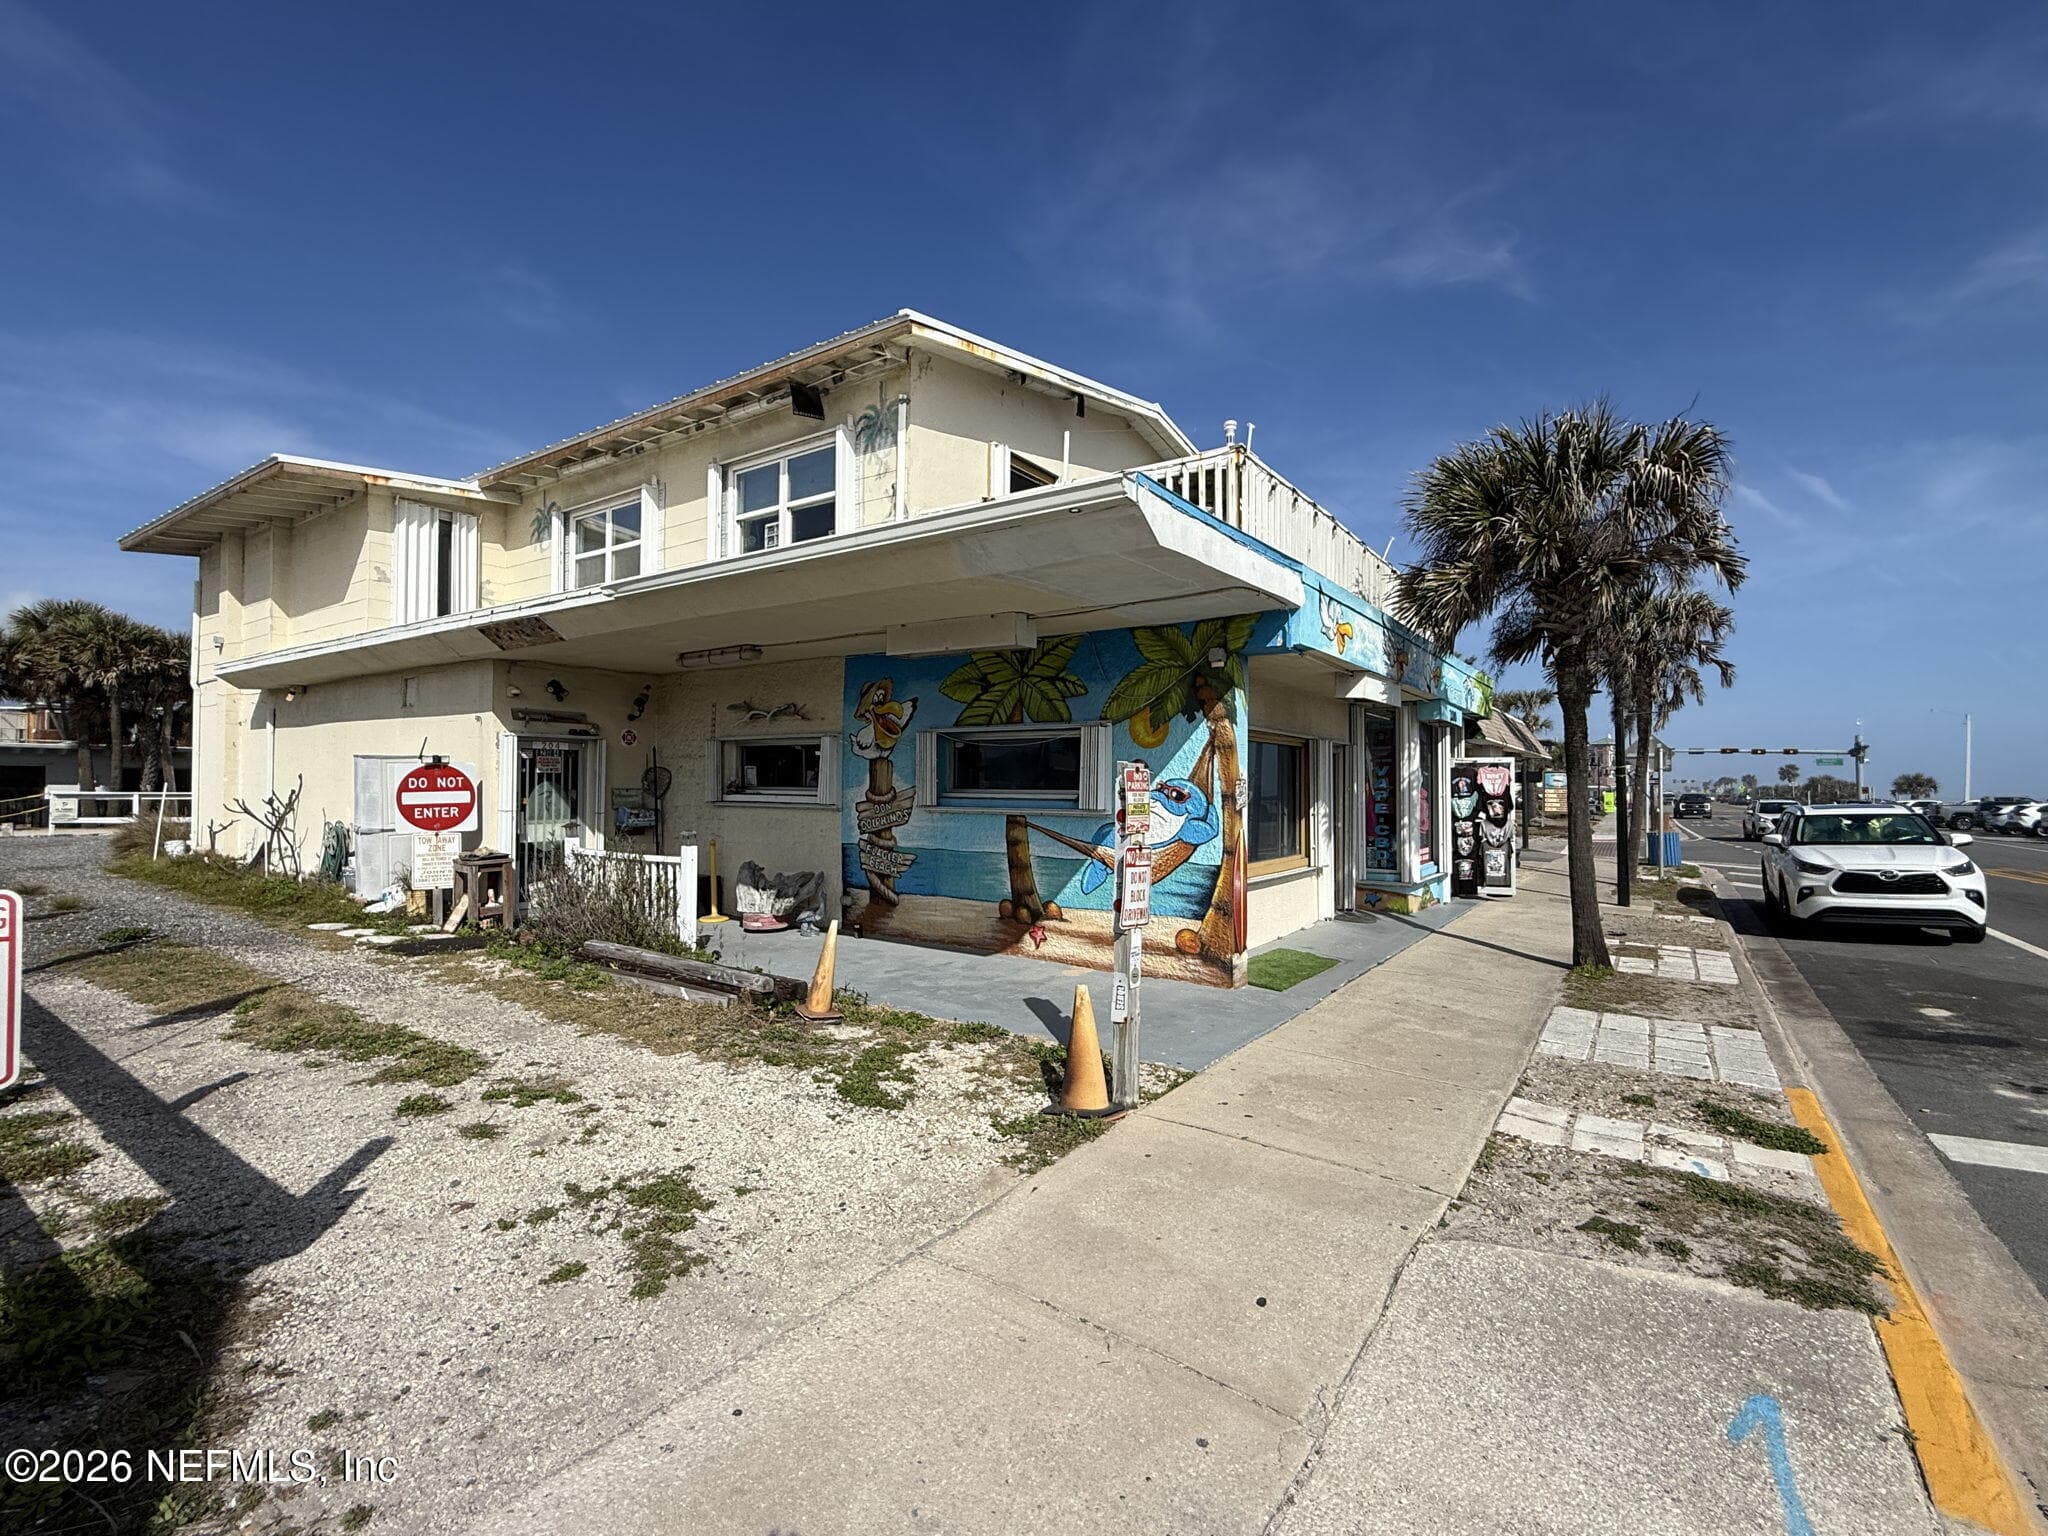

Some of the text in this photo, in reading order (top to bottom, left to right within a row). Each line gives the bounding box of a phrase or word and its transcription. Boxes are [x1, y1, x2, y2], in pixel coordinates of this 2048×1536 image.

[408, 777, 464, 788] DO NOT
[1127, 781, 1149, 790] PARKING
[1374, 765, 1391, 814] VAPE
[414, 807, 459, 819] ENTER
[874, 803, 892, 814] DON
[418, 836, 455, 845] TOW AWAY
[1127, 850, 1136, 865] NO
[869, 856, 898, 874] BEACH
[1130, 870, 1147, 885] DO NOT
[1130, 889, 1146, 903] BLOCK
